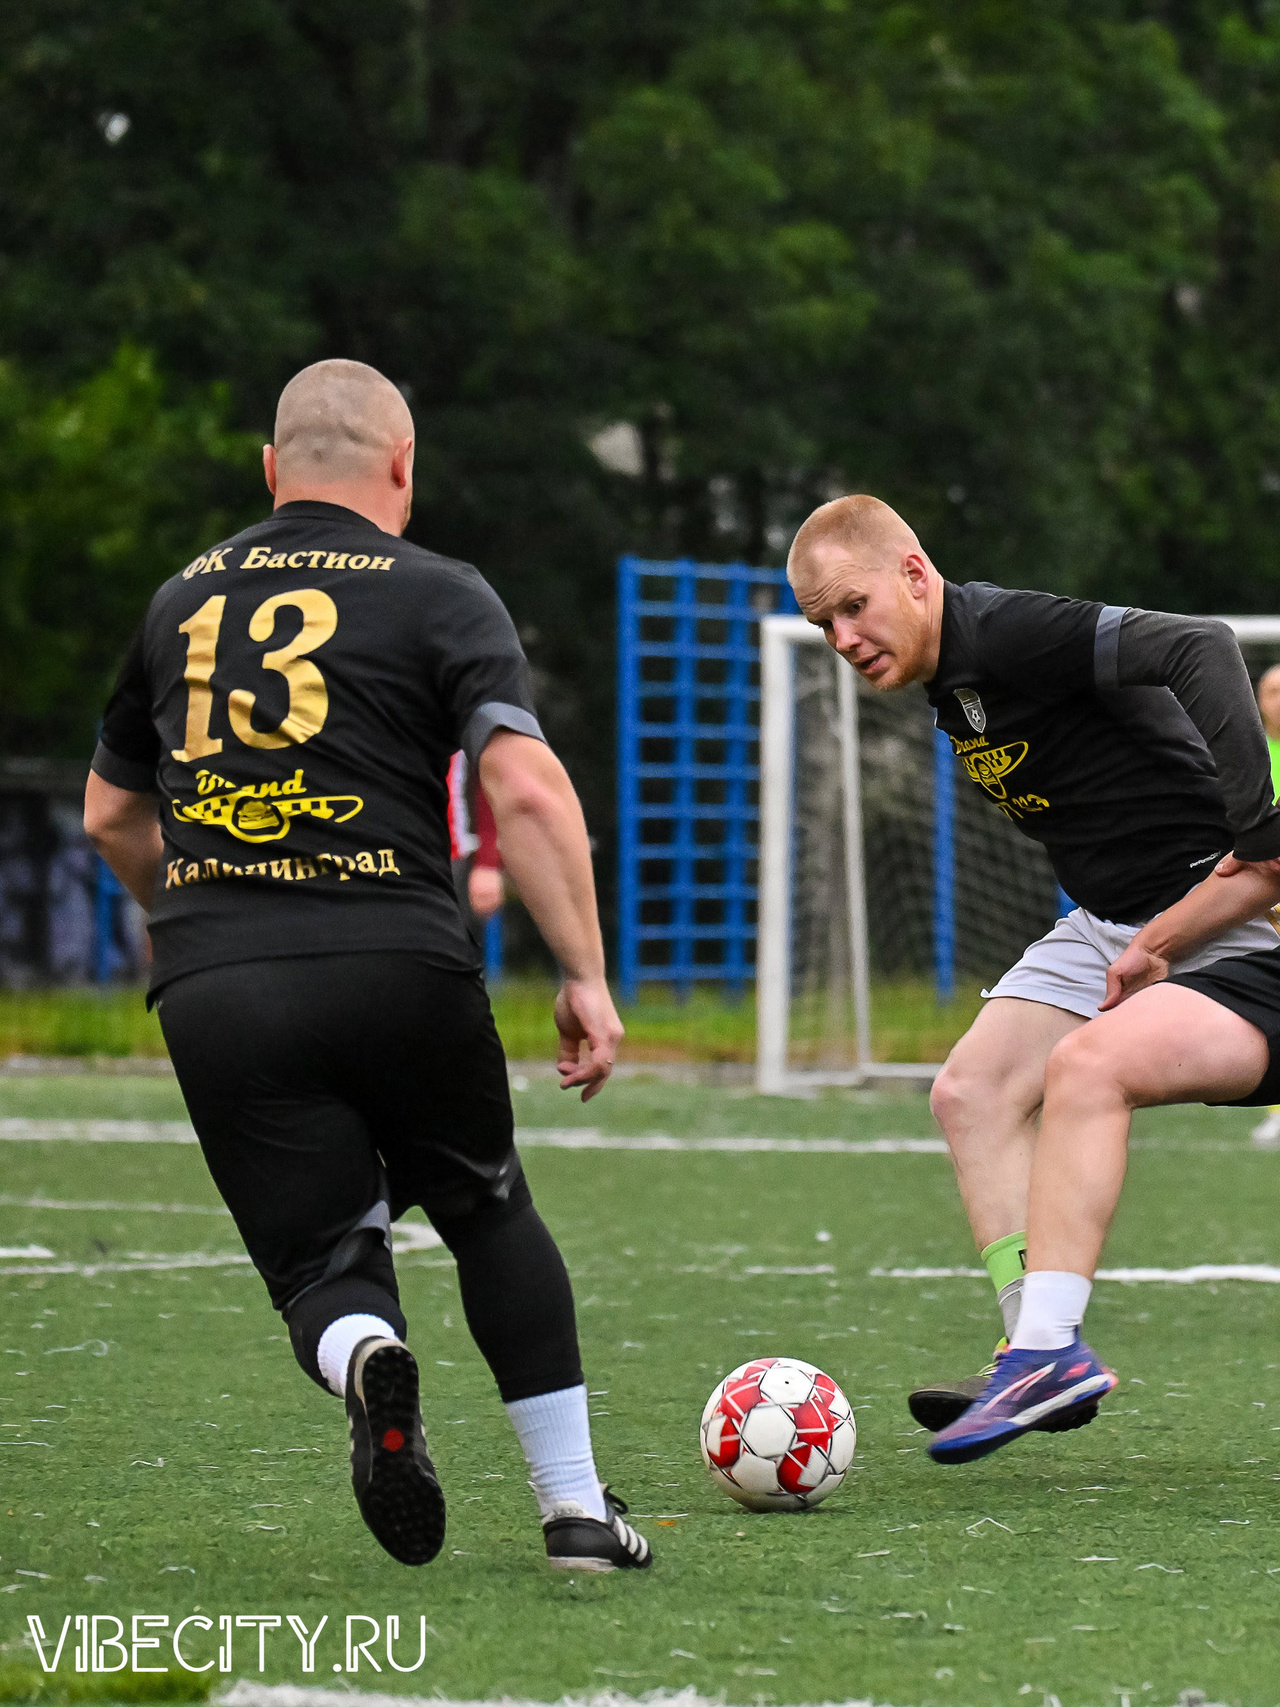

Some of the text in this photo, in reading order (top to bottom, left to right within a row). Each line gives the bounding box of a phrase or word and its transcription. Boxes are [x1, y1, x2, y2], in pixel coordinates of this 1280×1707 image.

[182, 546, 396, 580] ФК Бастион
[171, 588, 338, 763] 13
